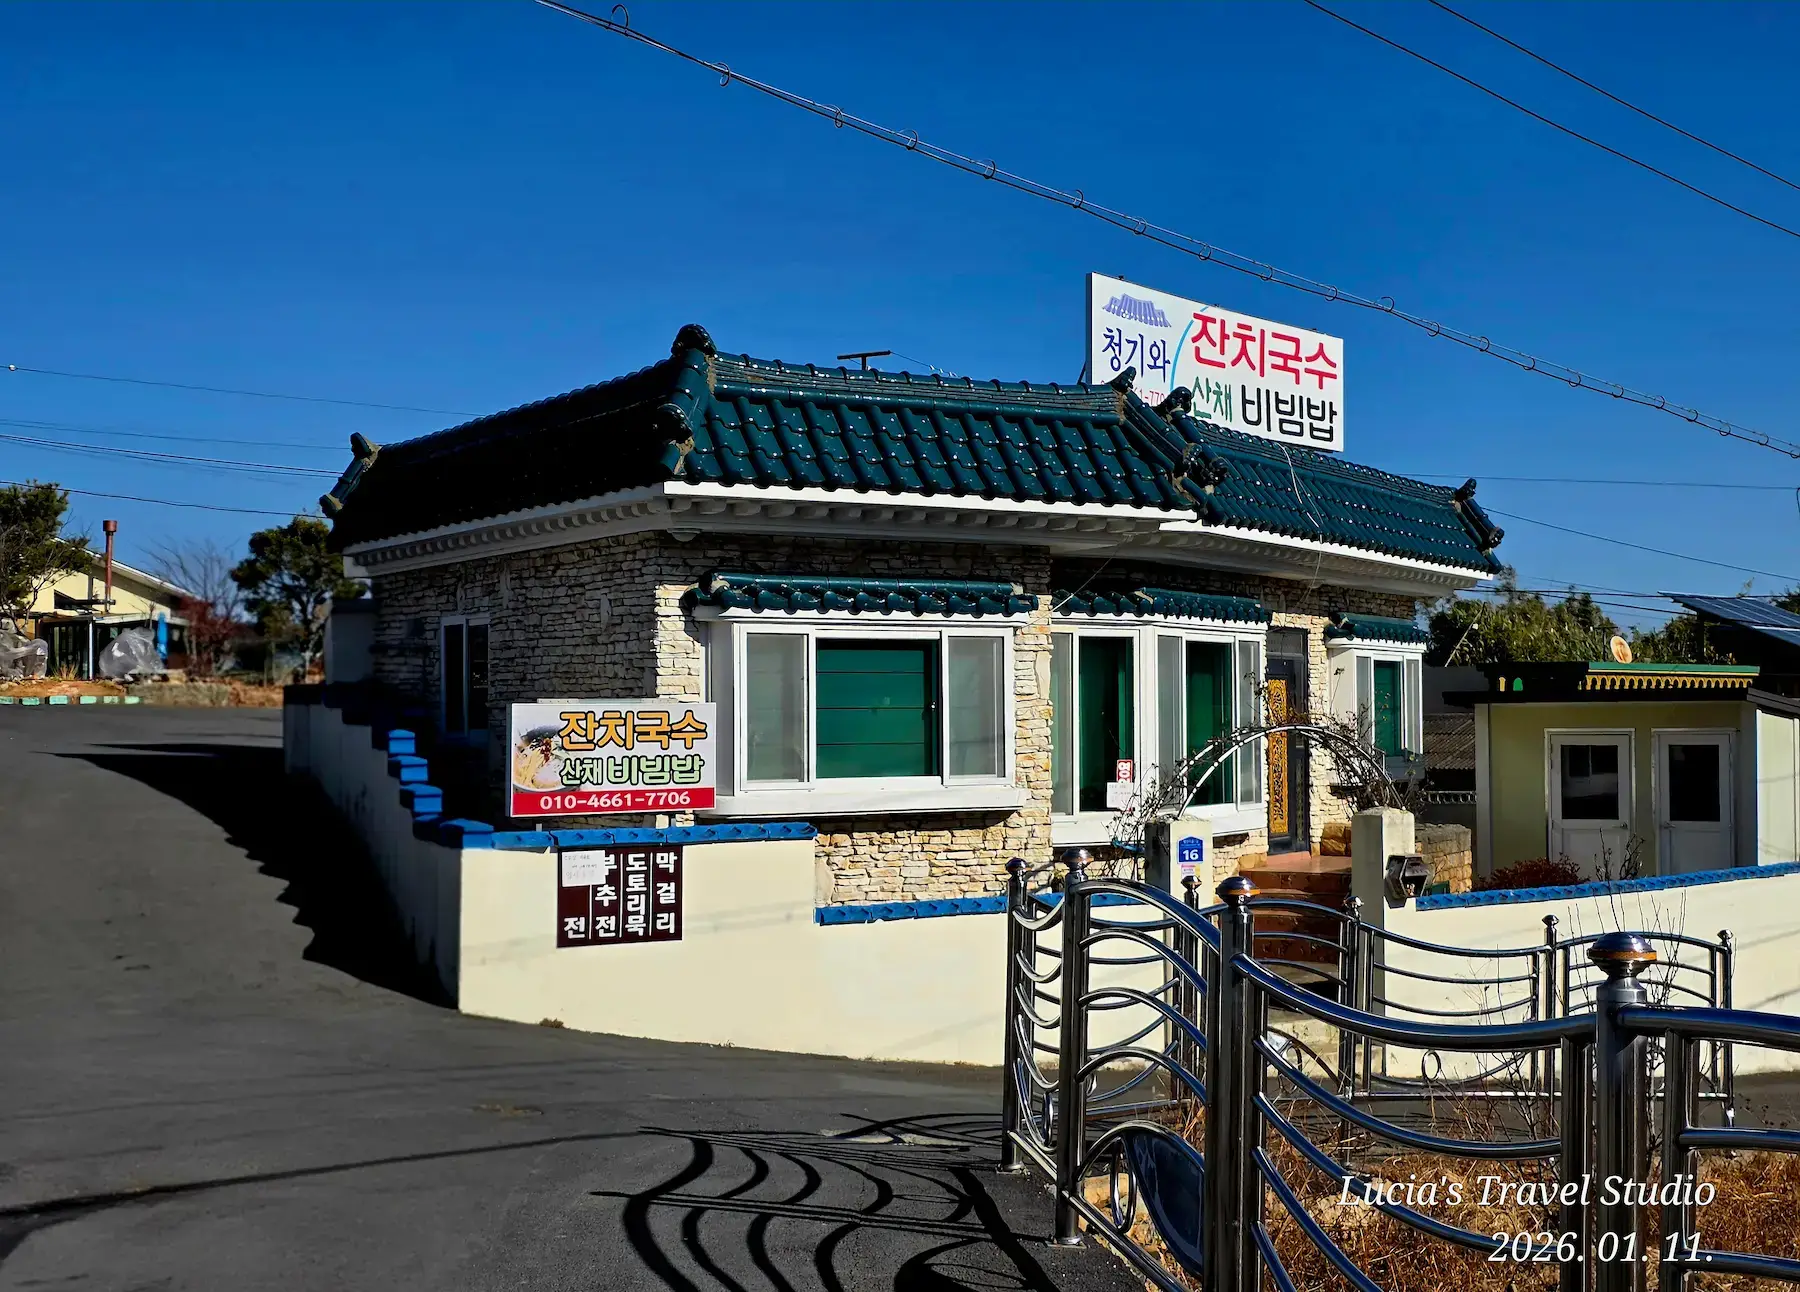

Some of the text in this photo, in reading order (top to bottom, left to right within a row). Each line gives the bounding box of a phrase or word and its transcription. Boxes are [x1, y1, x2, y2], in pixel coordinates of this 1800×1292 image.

[1102, 326, 1171, 383] 청기와
[1191, 312, 1338, 390] 잔치국수
[1192, 376, 1233, 422] 산채
[1241, 384, 1338, 442] 비빔밥
[558, 710, 708, 750] 잔치국수
[559, 754, 705, 786] 산채 비빔밥
[540, 791, 691, 810] 010-4661-7706
[1183, 849, 1199, 860] 16
[625, 853, 648, 937] 도토리묵
[655, 852, 678, 934] 막걸리
